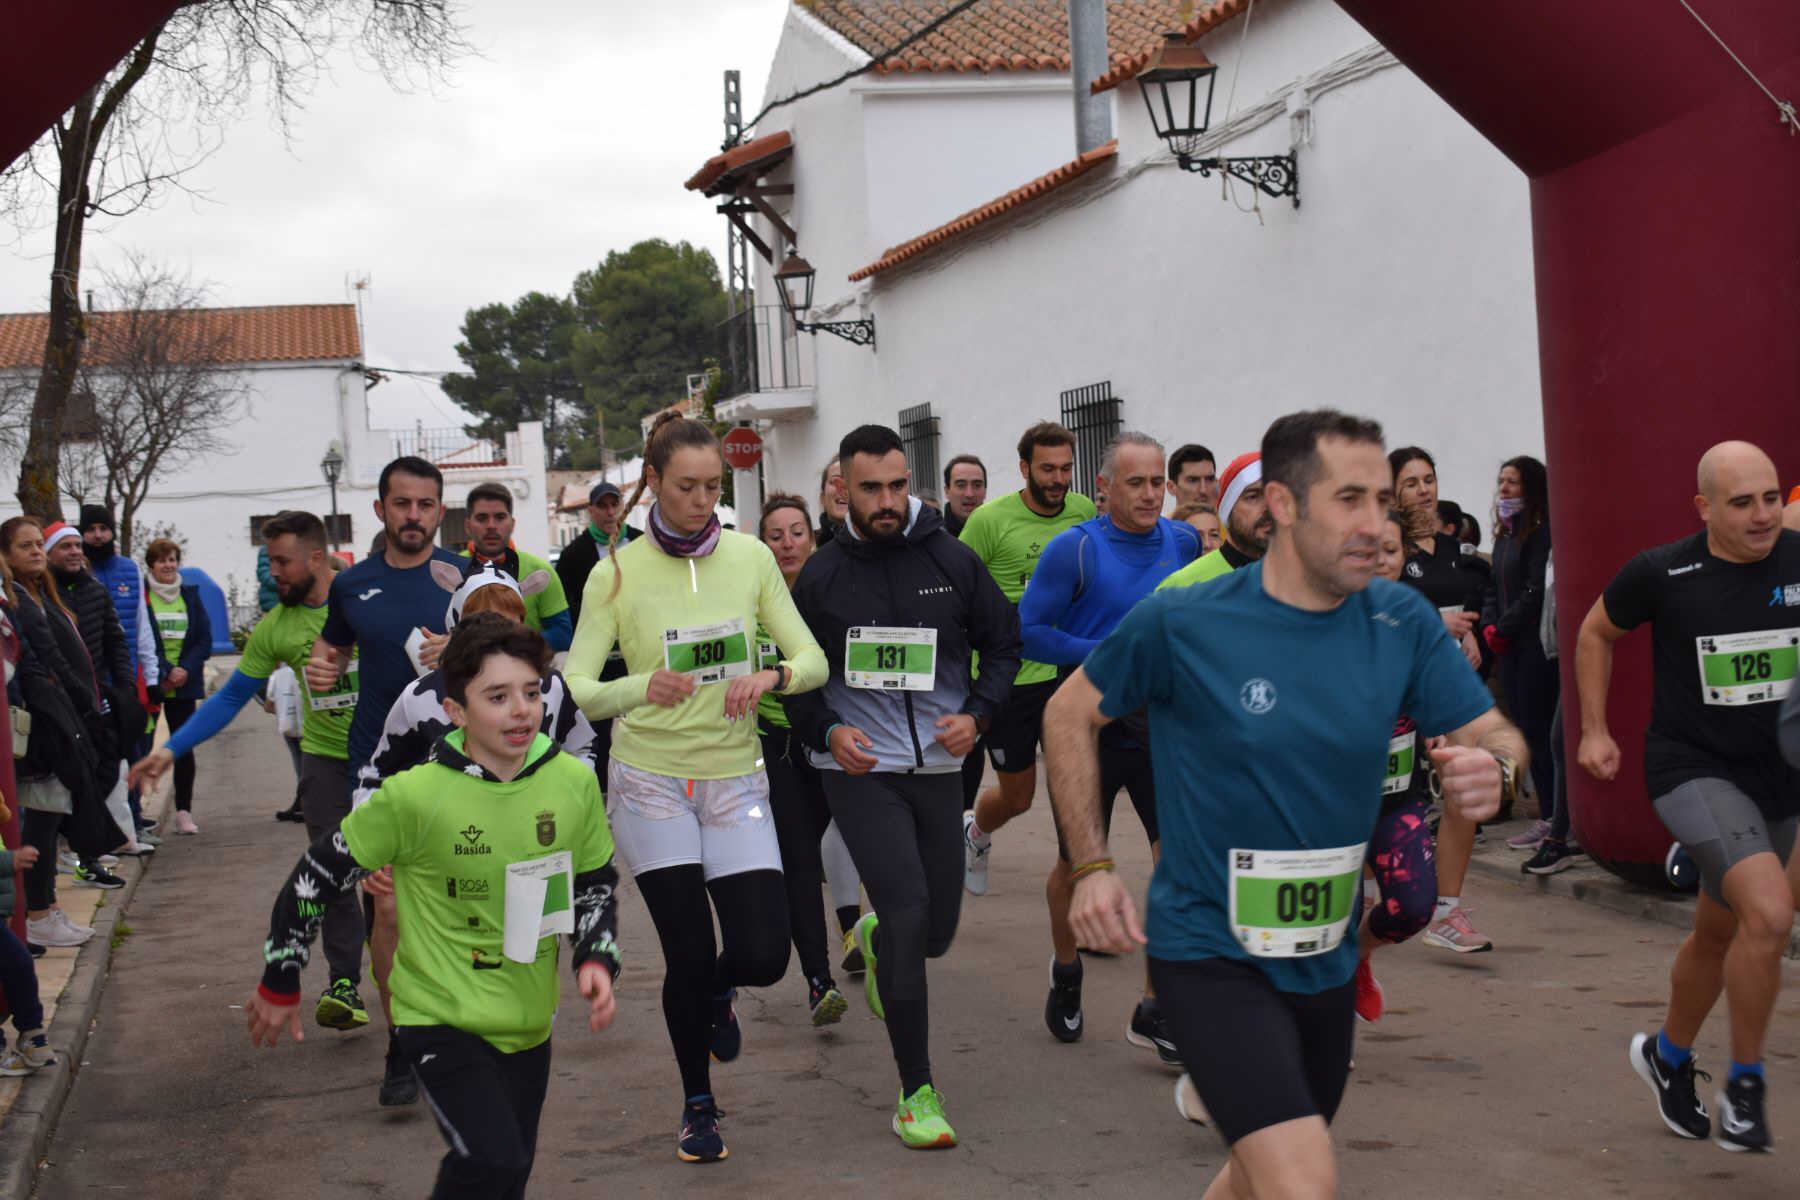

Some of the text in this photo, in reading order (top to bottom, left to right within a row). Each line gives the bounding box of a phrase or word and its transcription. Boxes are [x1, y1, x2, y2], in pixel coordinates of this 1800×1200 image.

[726, 443, 761, 454] STOP
[691, 640, 726, 666] 130
[875, 645, 906, 670] 131
[1731, 652, 1772, 682] 126
[328, 673, 353, 694] 34
[454, 843, 492, 856] Basida
[459, 879, 490, 892] SOSA
[1276, 879, 1334, 923] 091
